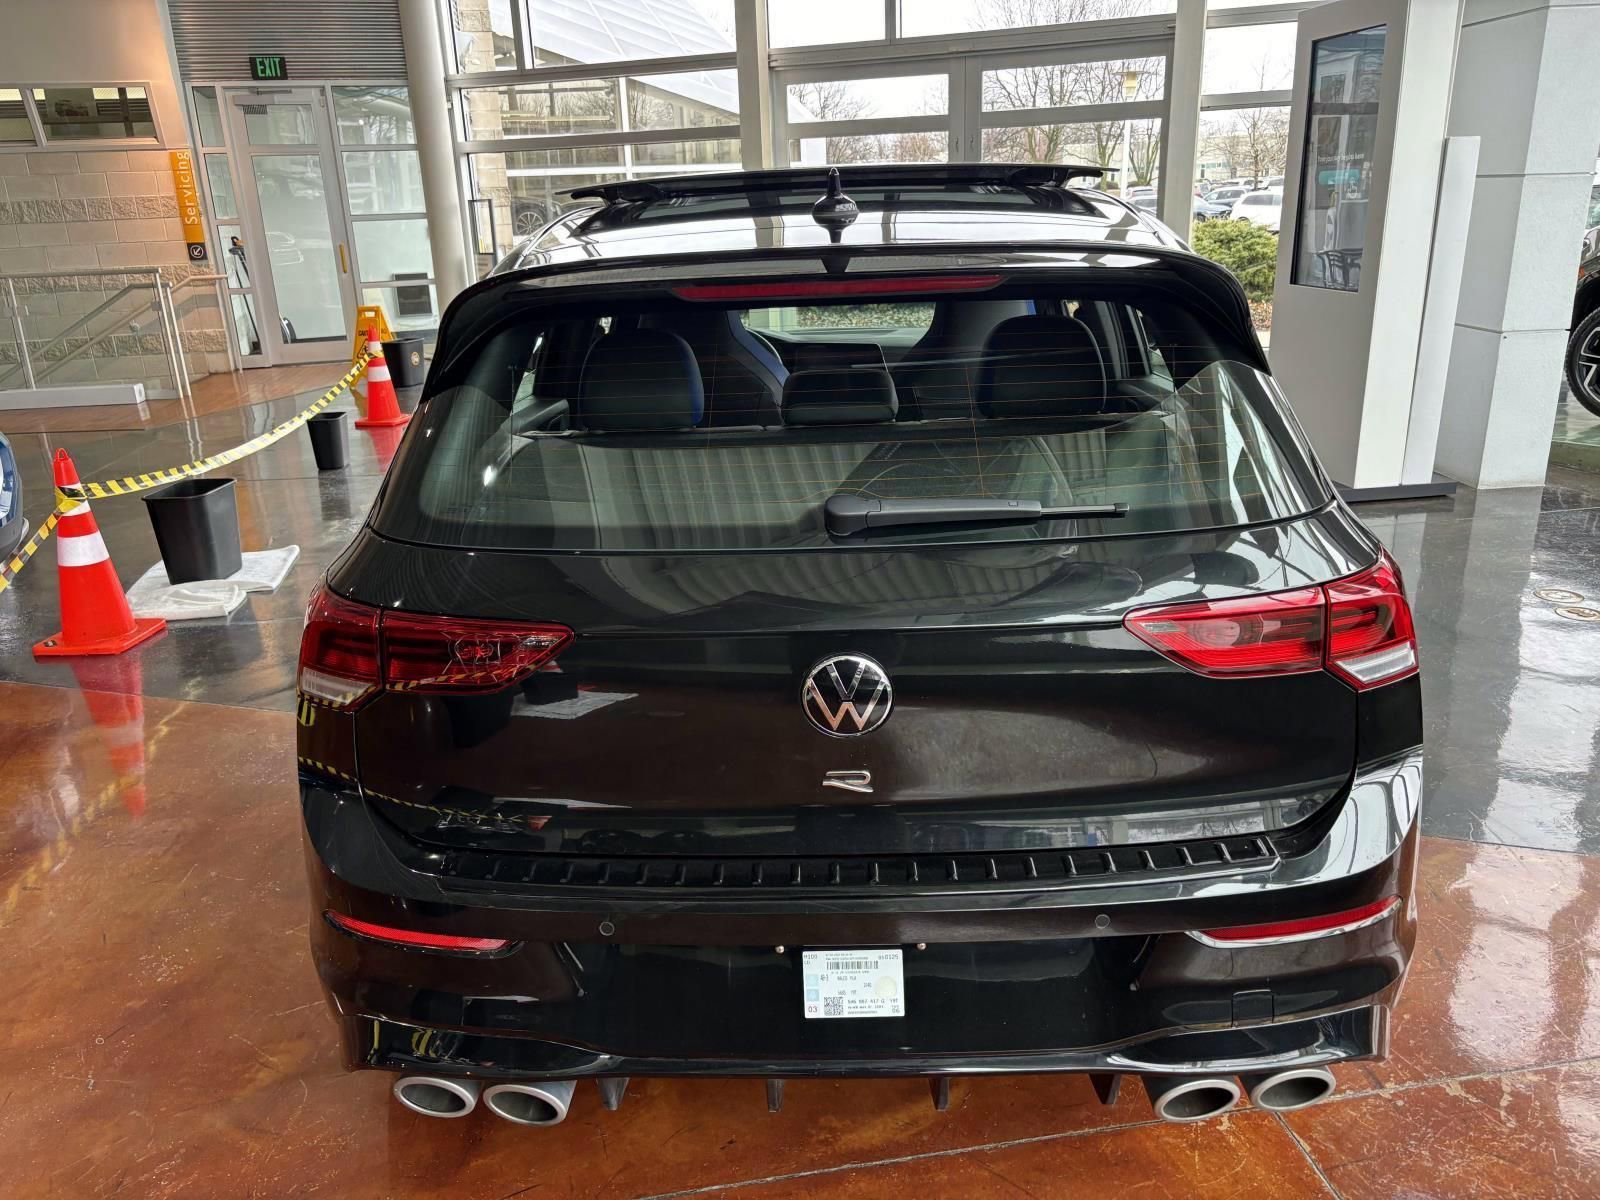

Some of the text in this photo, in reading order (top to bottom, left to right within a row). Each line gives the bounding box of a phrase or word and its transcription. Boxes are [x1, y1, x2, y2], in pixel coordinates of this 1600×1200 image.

[255, 57, 281, 77] EXIT
[177, 151, 198, 225] Servicing
[804, 656, 892, 735] VW
[822, 770, 874, 793] R
